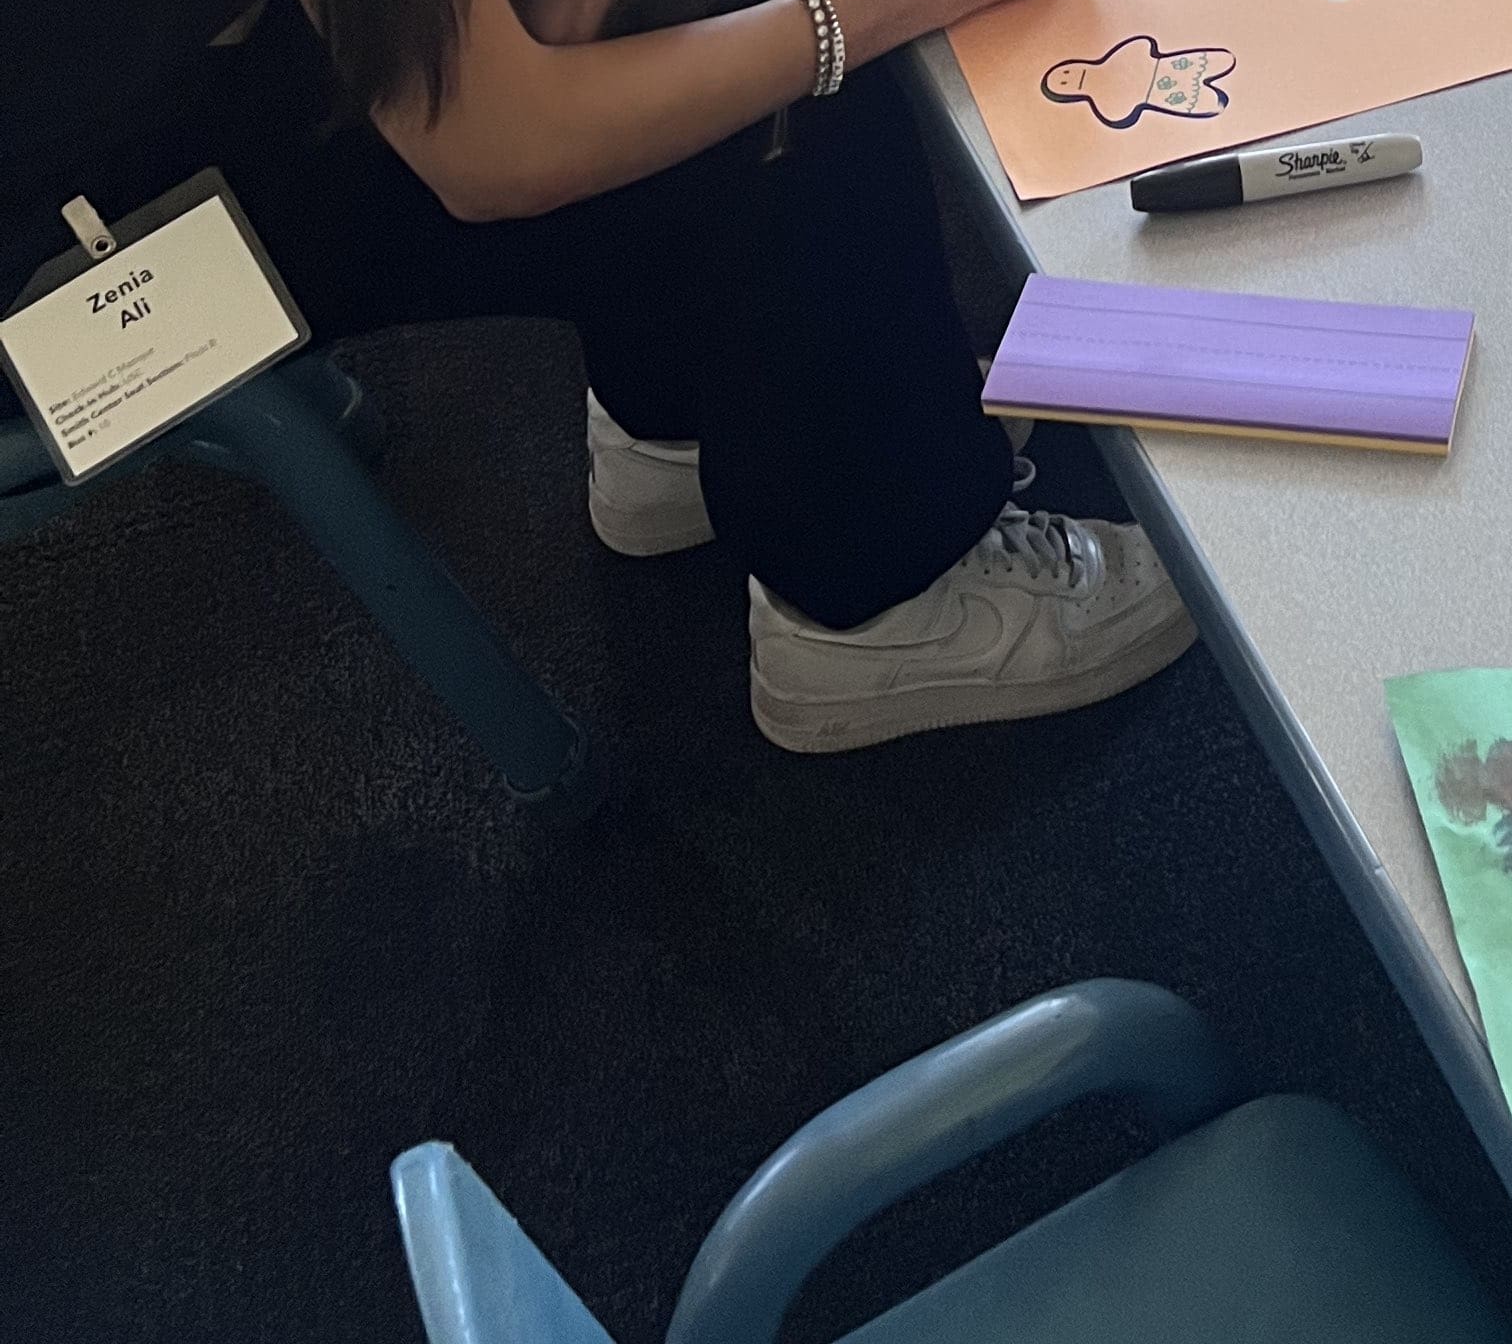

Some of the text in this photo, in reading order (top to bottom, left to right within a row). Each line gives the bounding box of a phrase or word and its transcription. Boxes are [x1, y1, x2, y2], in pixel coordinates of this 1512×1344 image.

[1275, 148, 1347, 178] Sharpie
[86, 267, 154, 314] Zenia
[119, 297, 152, 330] Ali
